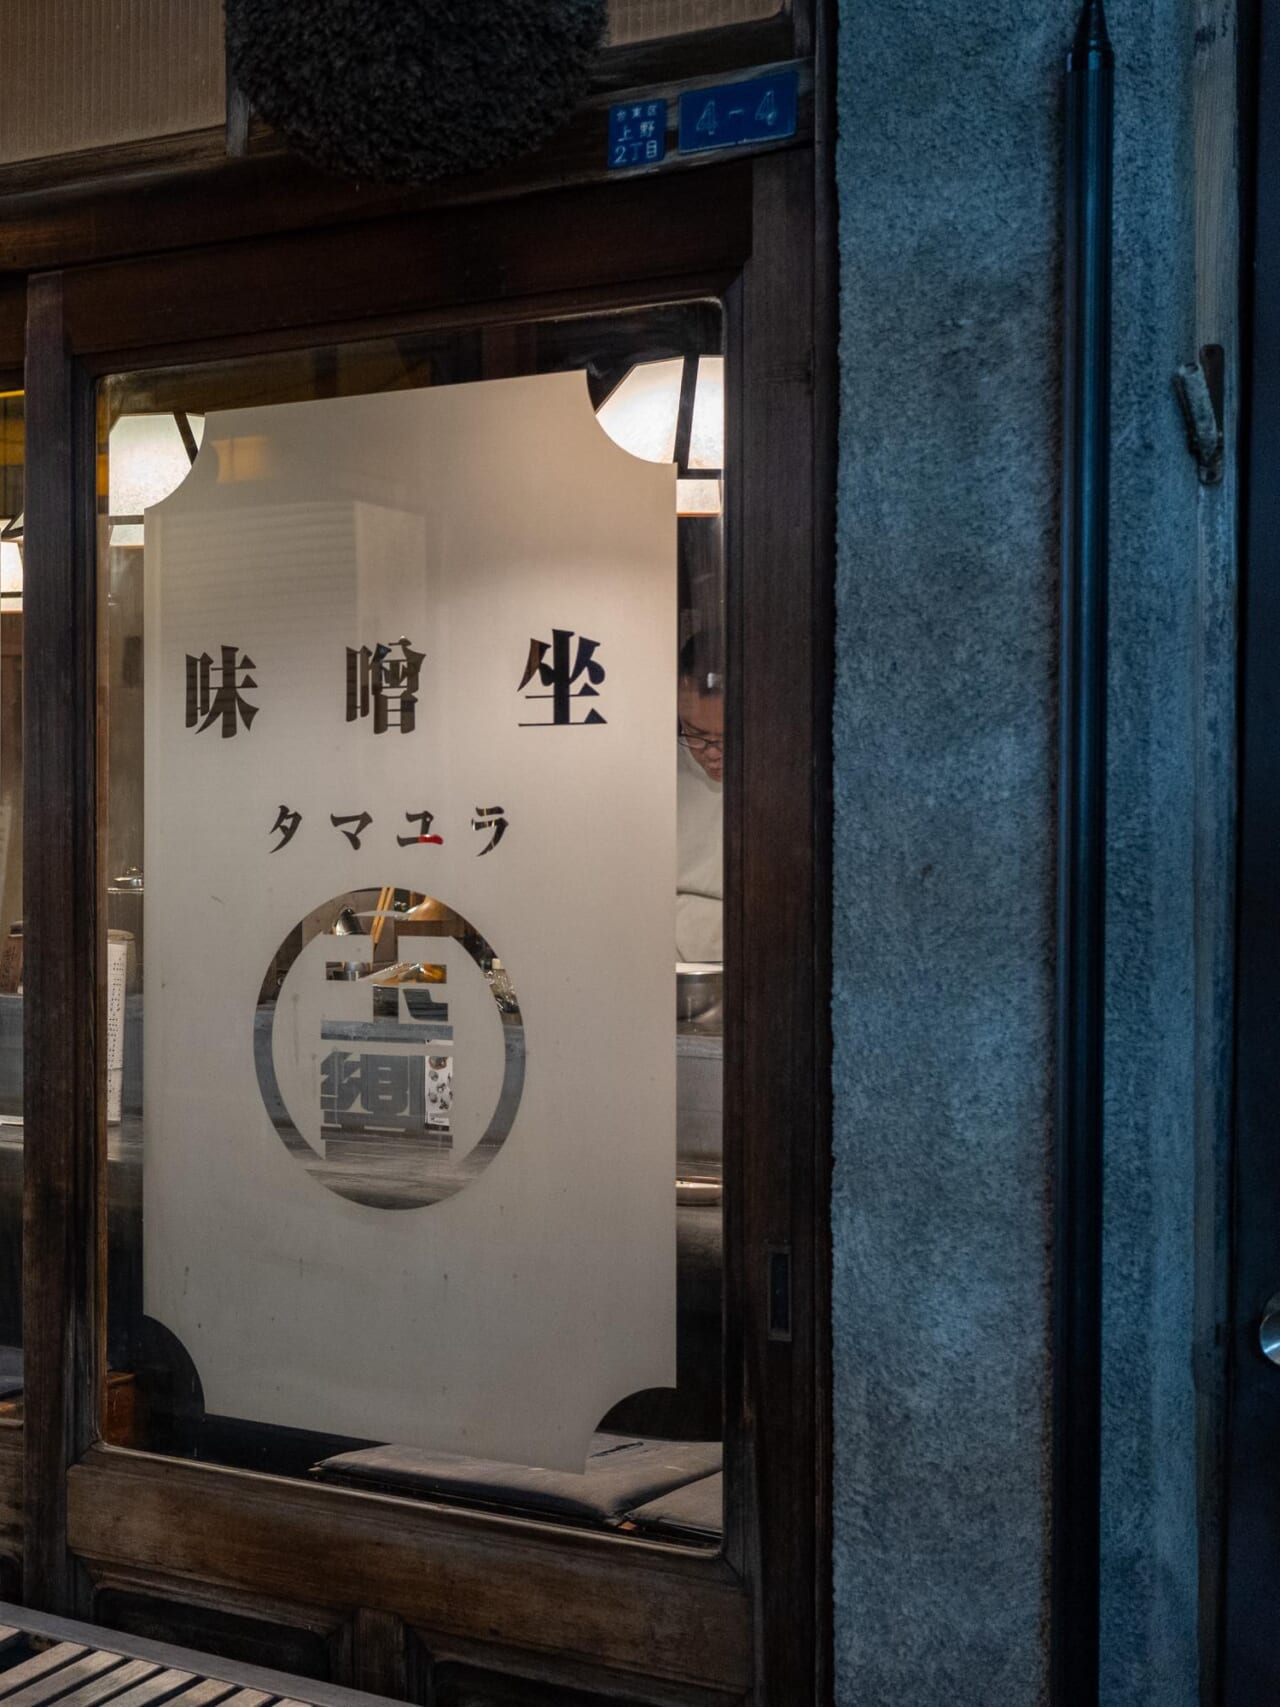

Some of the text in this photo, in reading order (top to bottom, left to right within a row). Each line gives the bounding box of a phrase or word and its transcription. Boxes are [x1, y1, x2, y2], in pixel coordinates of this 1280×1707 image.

[616, 103, 658, 121] 台東区
[695, 90, 778, 136] 4-4
[617, 120, 656, 142] 上野
[613, 139, 658, 165] 2丁目
[184, 628, 609, 739] 味噌坐
[269, 804, 510, 857] タマユラ
